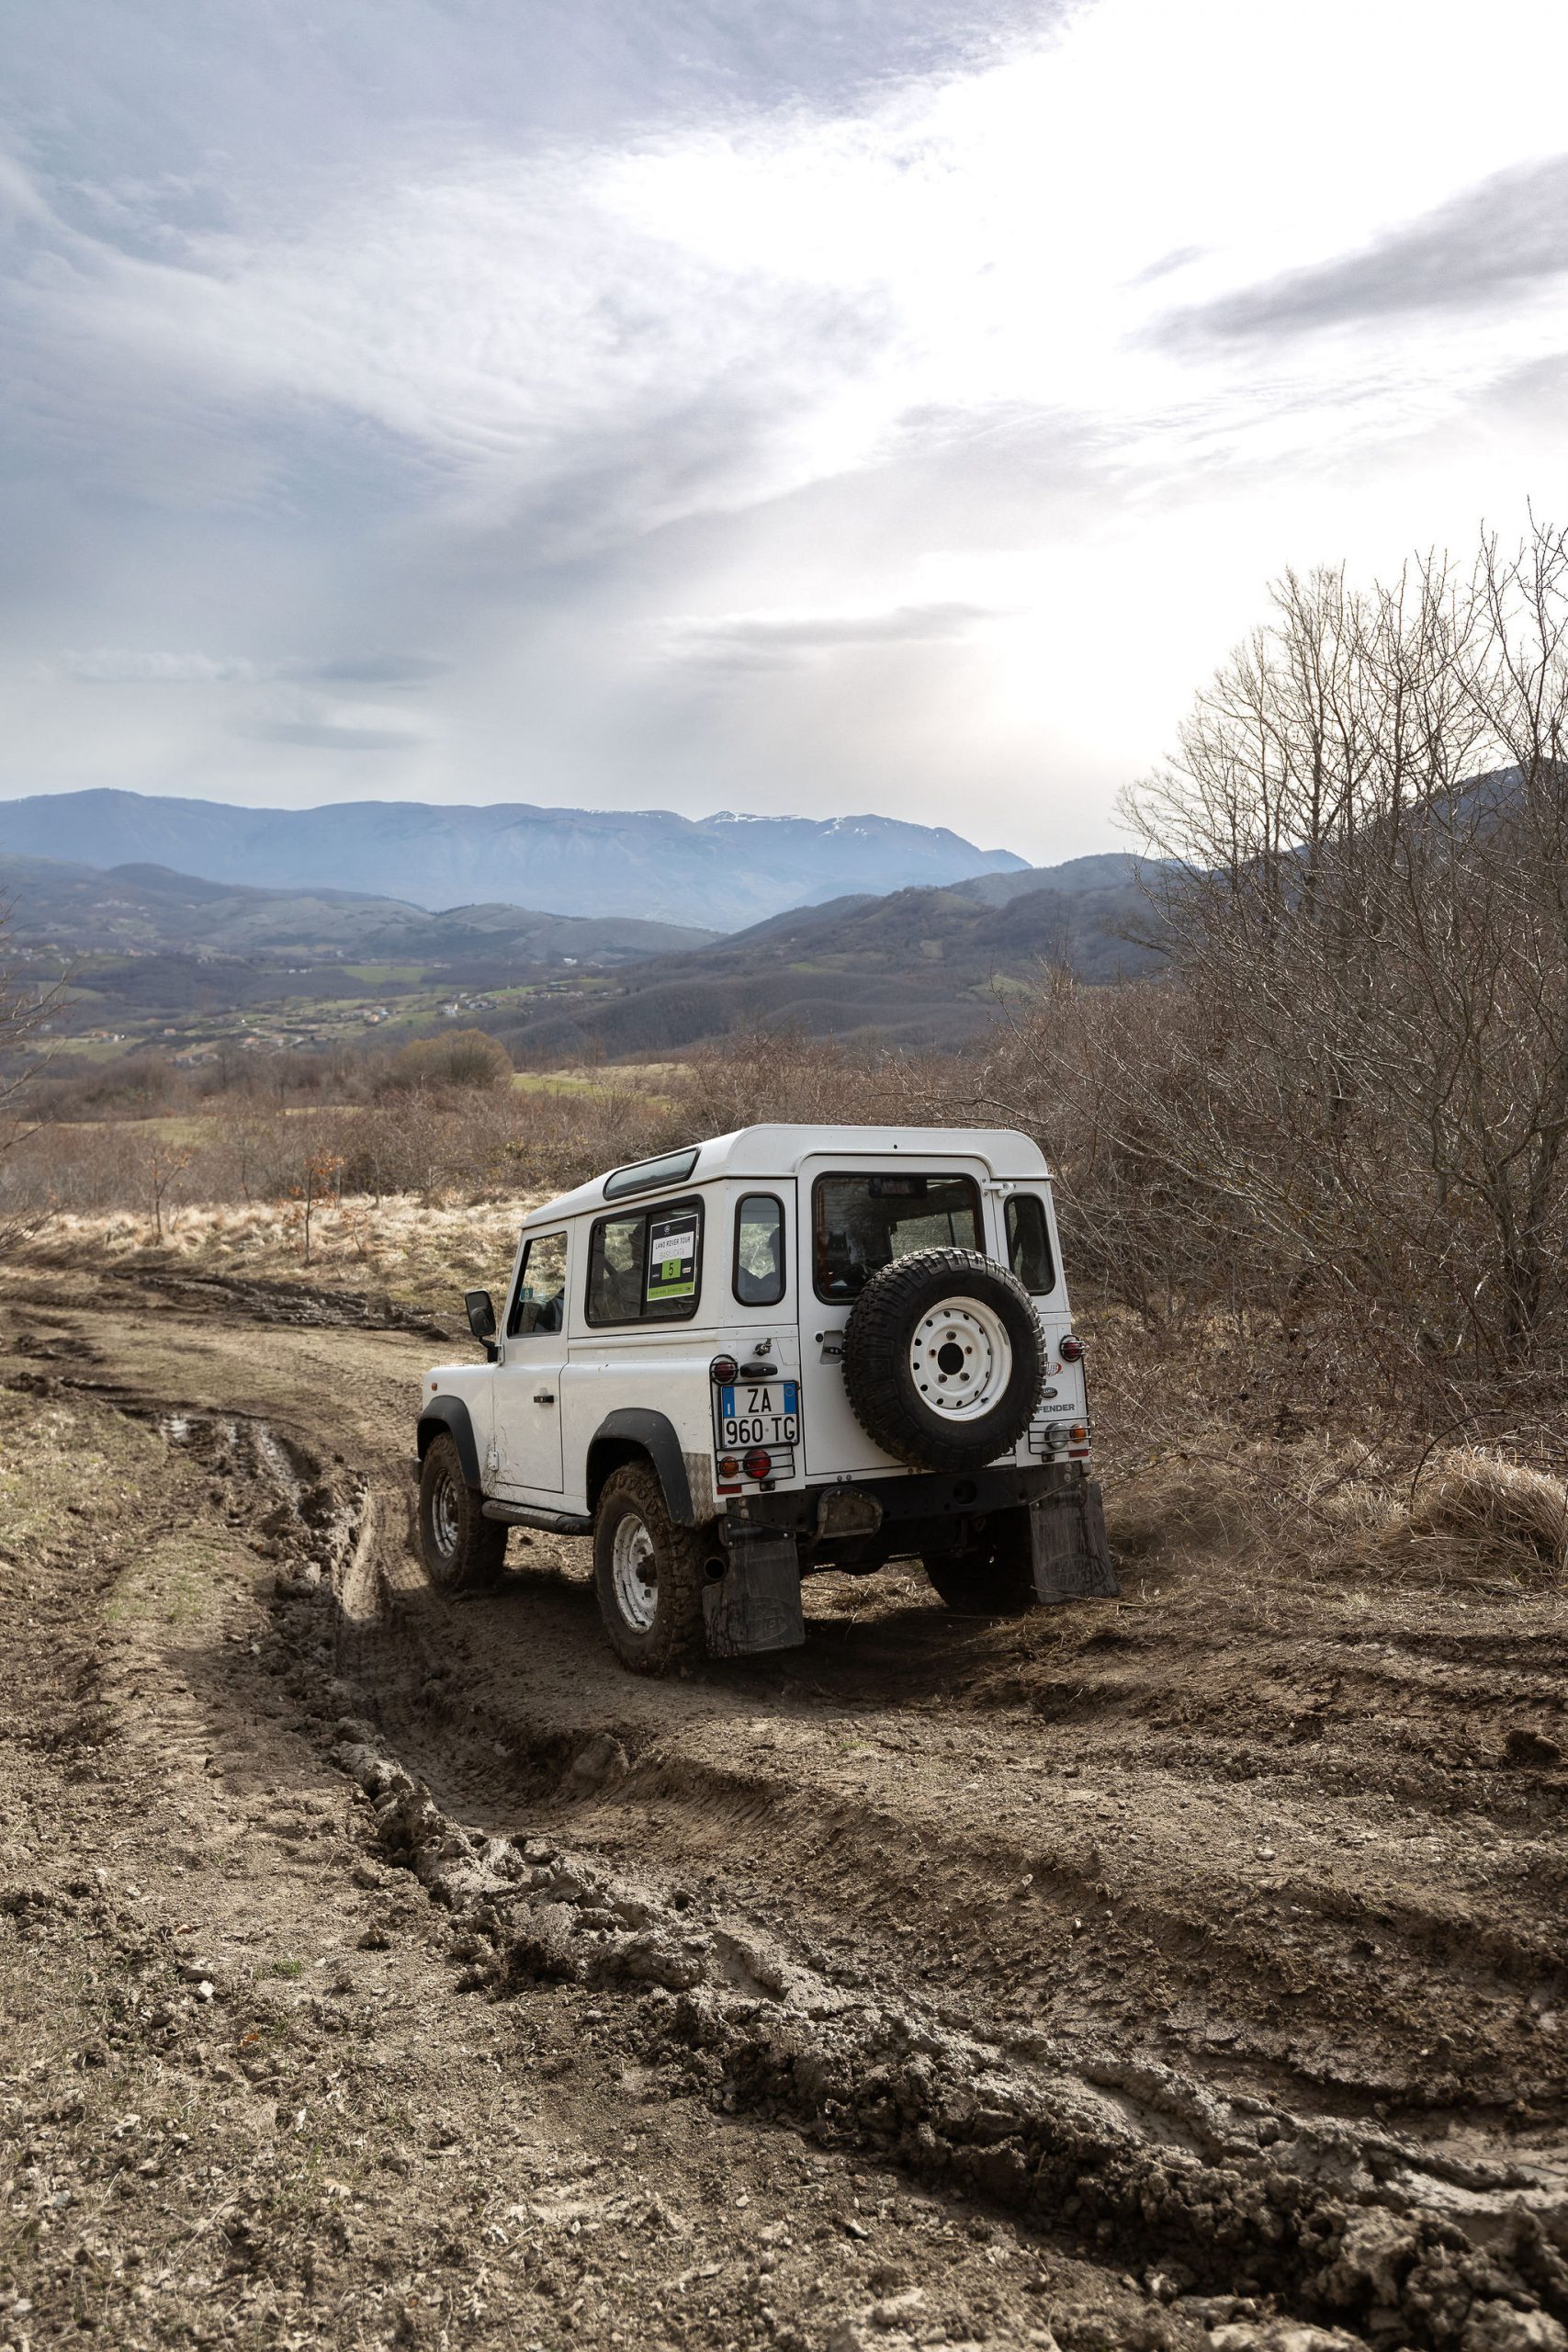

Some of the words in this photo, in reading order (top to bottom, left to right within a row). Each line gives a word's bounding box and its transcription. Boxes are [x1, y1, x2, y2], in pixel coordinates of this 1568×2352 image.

[655, 1241, 666, 1250] LAND
[666, 1238, 679, 1247] ROVER
[680, 1236, 691, 1244] TOUR
[669, 1262, 674, 1276] 5
[747, 1387, 773, 1414] ZA
[1037, 1403, 1075, 1414] FENDER
[726, 1418, 763, 1445] 960
[771, 1416, 795, 1442] TG
